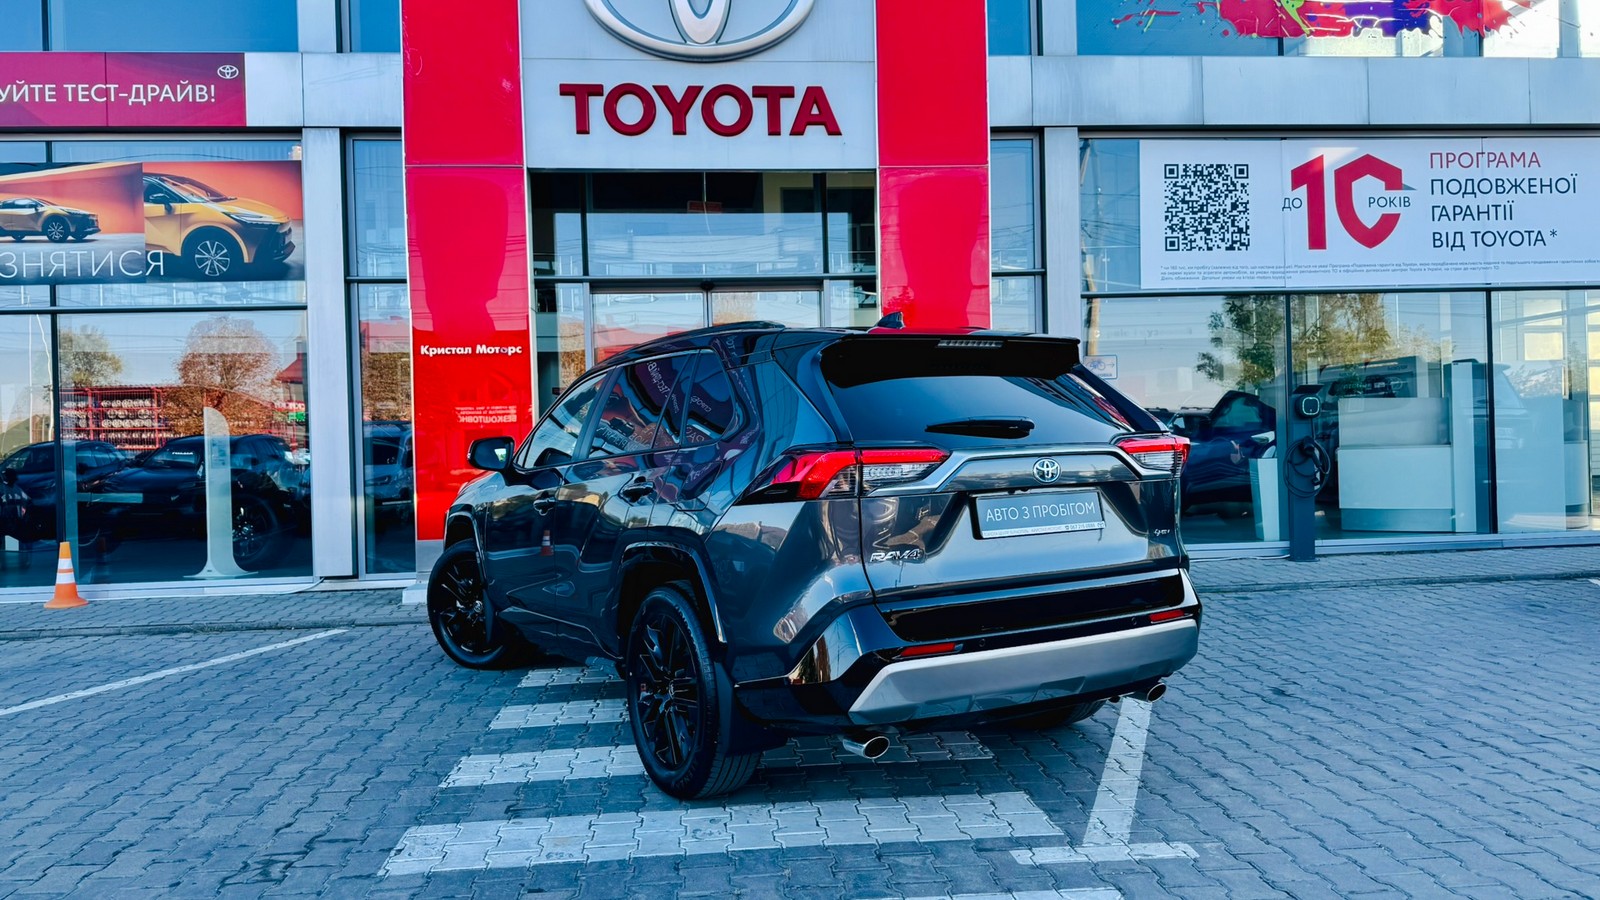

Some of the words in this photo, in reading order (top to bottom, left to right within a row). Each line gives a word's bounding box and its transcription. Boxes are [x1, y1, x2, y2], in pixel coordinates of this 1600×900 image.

[0, 80, 56, 102] УЙТЕ
[63, 80, 216, 105] ТЕСТ-ДРАЙВ!
[559, 82, 842, 137] TOYOTA
[1429, 151, 1541, 169] ПРОГРАМА
[1430, 172, 1578, 199] ПОДОВЖЕНОЇ
[1281, 197, 1303, 212] ДО
[1367, 195, 1412, 208] РОКІВ
[1431, 202, 1514, 222] ГАРАНТІЇ
[1432, 231, 1466, 251] ВІД
[0, 250, 165, 278] ЗНЯТИСЯ
[420, 344, 472, 356] Кристал
[475, 344, 523, 355] Моторс
[986, 507, 1019, 522] АВТО
[1032, 501, 1096, 519] ПРОБІГОМ
[870, 549, 919, 562] RAV4
